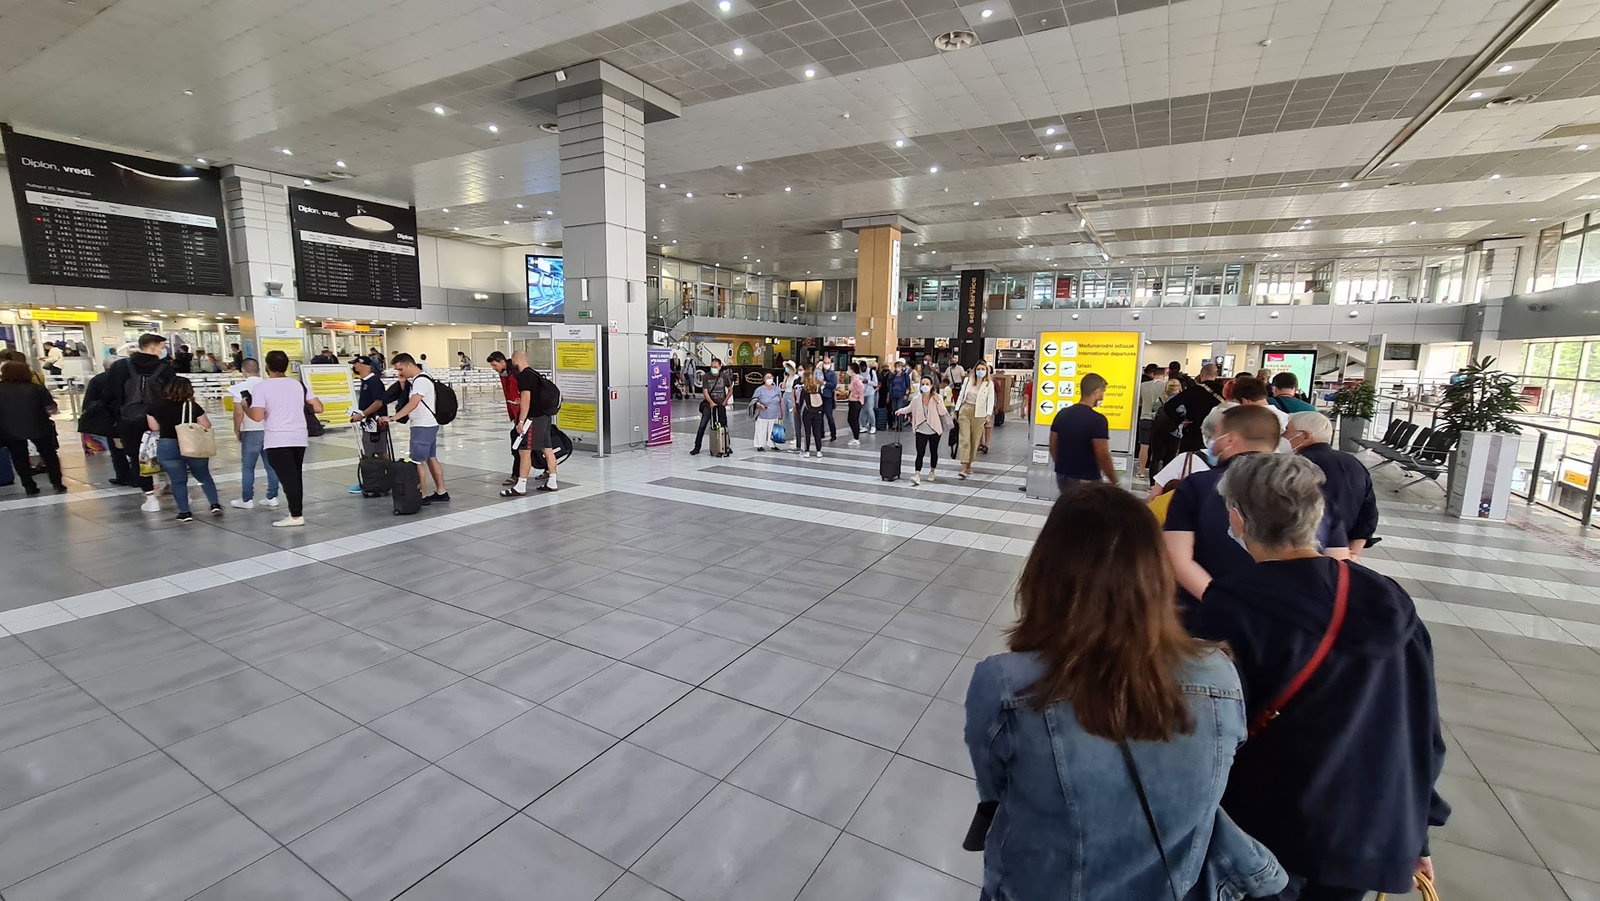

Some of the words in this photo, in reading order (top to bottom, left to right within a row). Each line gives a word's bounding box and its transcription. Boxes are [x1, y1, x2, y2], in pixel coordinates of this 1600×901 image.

[62, 165, 96, 177] vredi.
[969, 277, 977, 307] service
[967, 307, 975, 324] self
